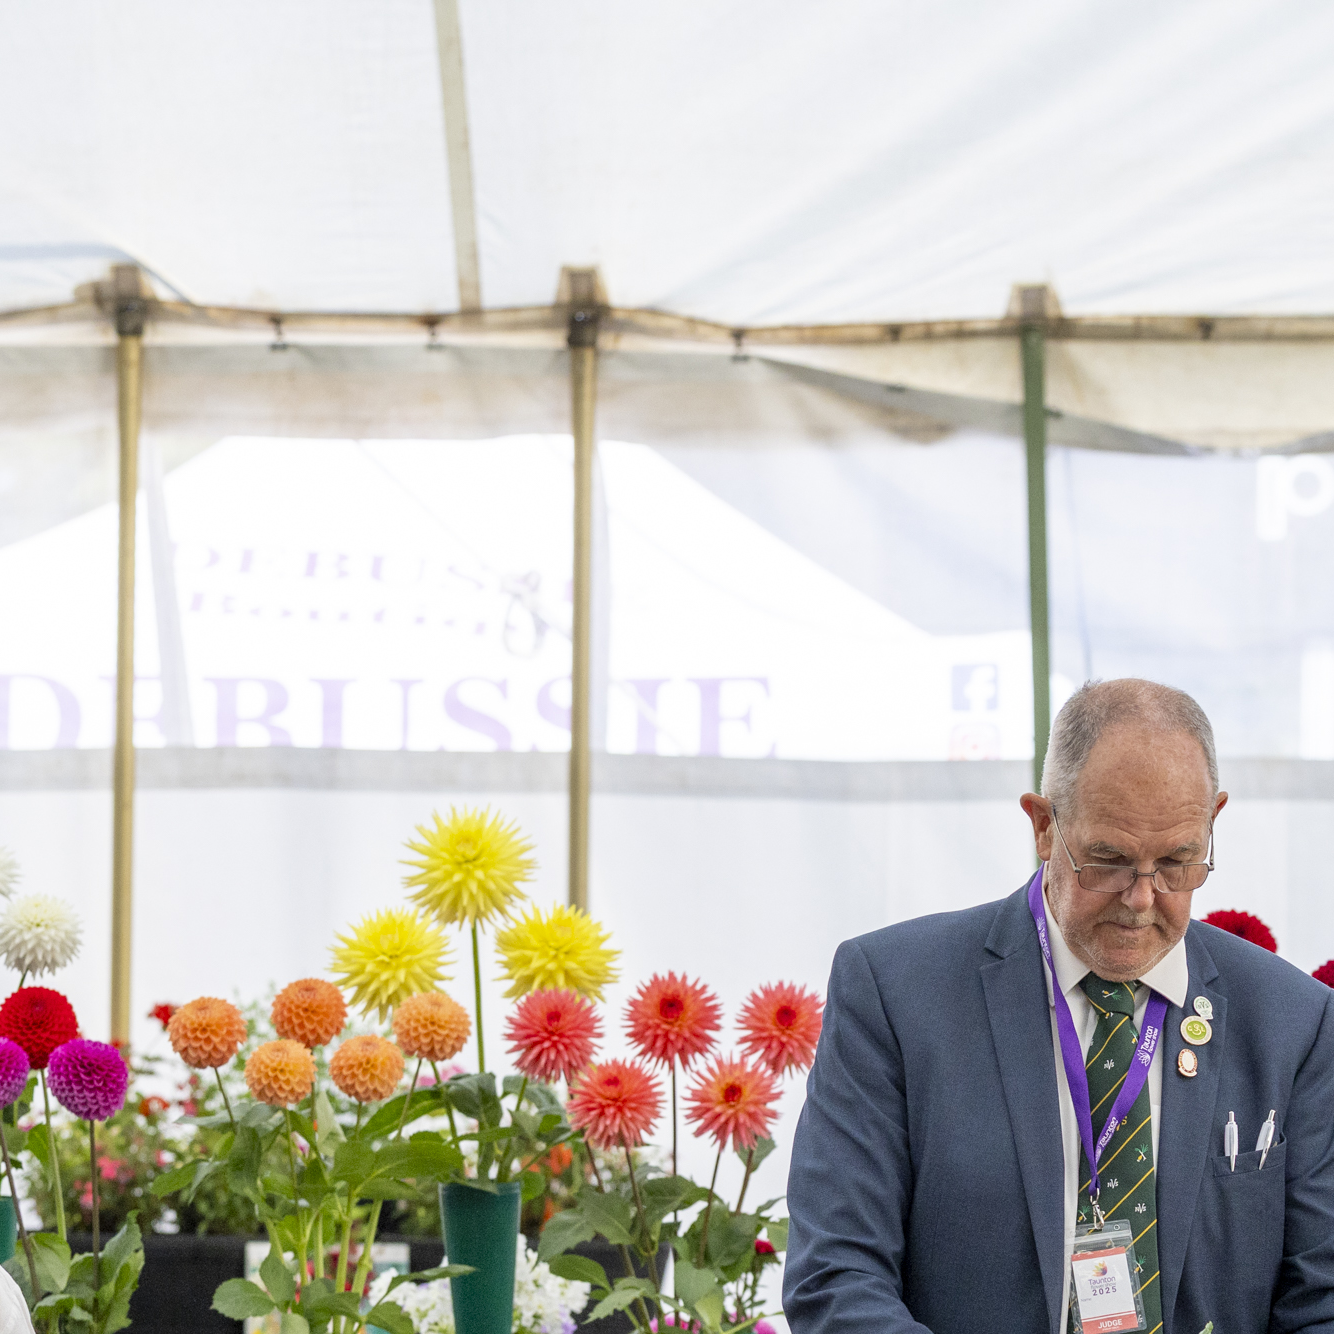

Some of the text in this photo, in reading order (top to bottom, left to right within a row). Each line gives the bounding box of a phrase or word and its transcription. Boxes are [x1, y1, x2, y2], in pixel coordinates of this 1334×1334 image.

[1140, 1025, 1154, 1051] Taunton
[1088, 1276, 1116, 1285] Taunton
[1092, 1286, 1117, 1296] 2025
[1098, 1318, 1123, 1329] JUDGE
